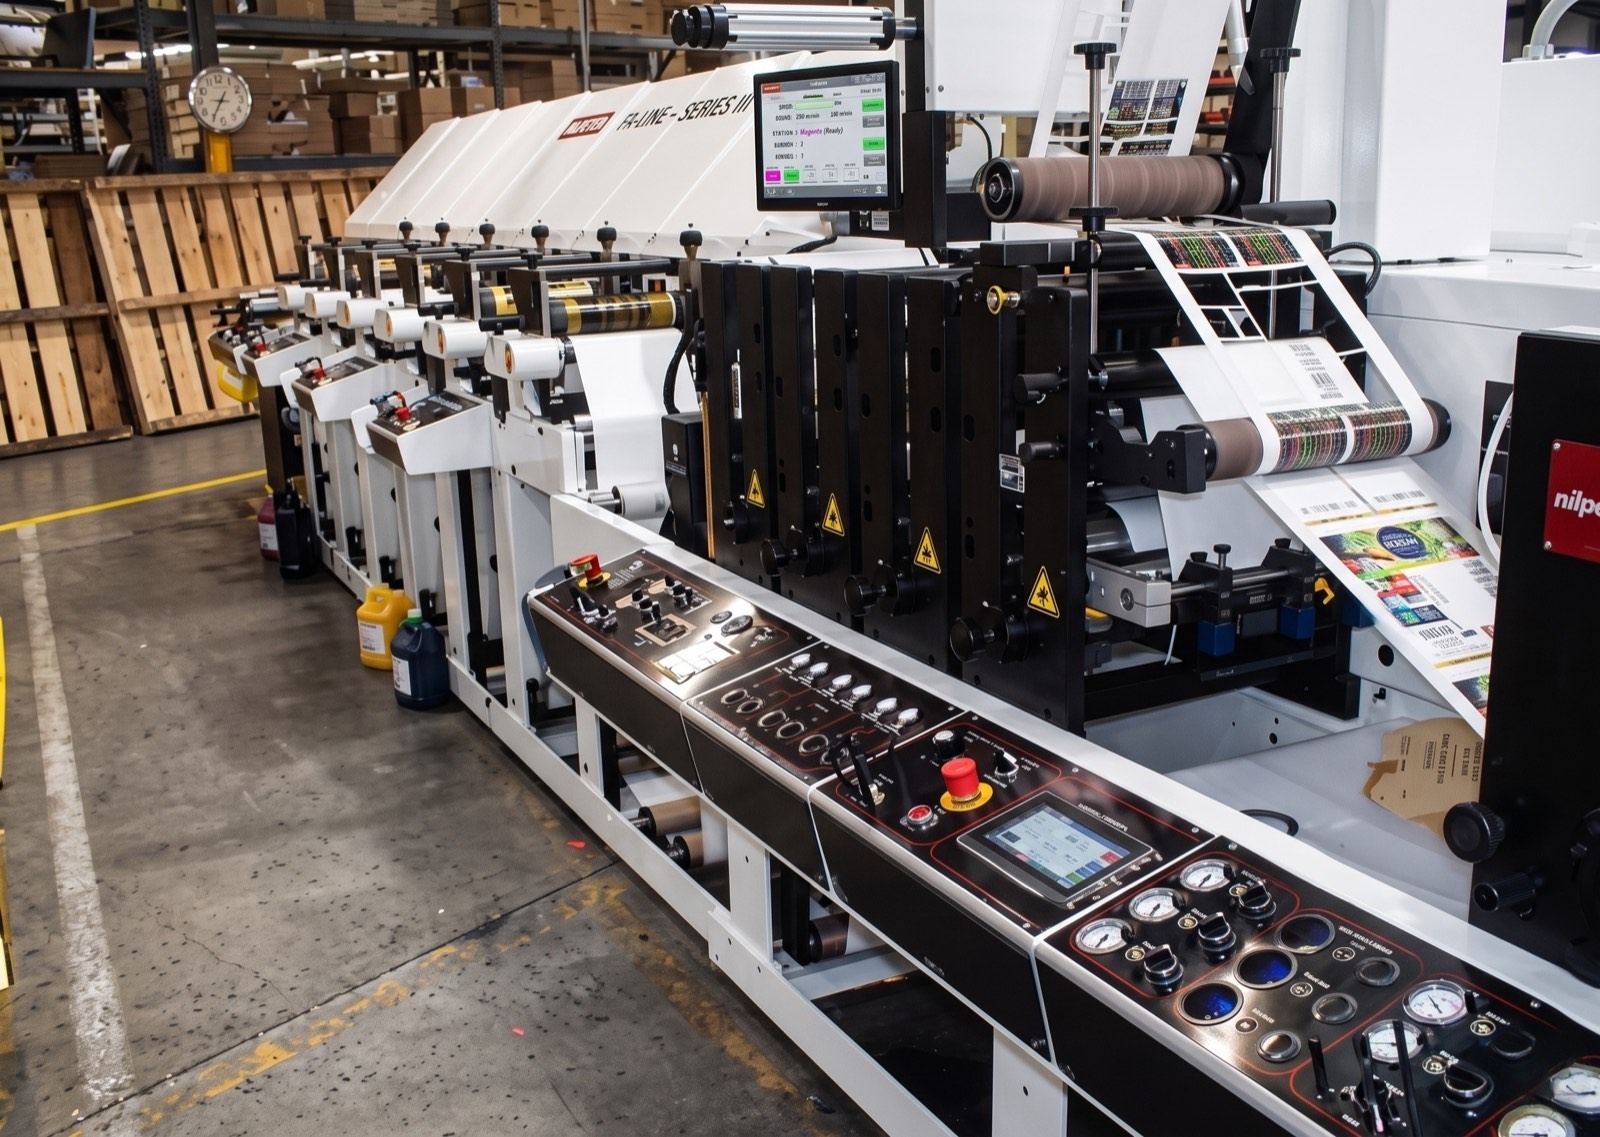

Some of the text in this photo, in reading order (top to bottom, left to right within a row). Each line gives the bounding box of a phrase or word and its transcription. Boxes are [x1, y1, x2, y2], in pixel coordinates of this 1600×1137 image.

[214, 74, 222, 84] 12
[677, 95, 737, 122] SERIES
[823, 127, 843, 136] (Ready)
